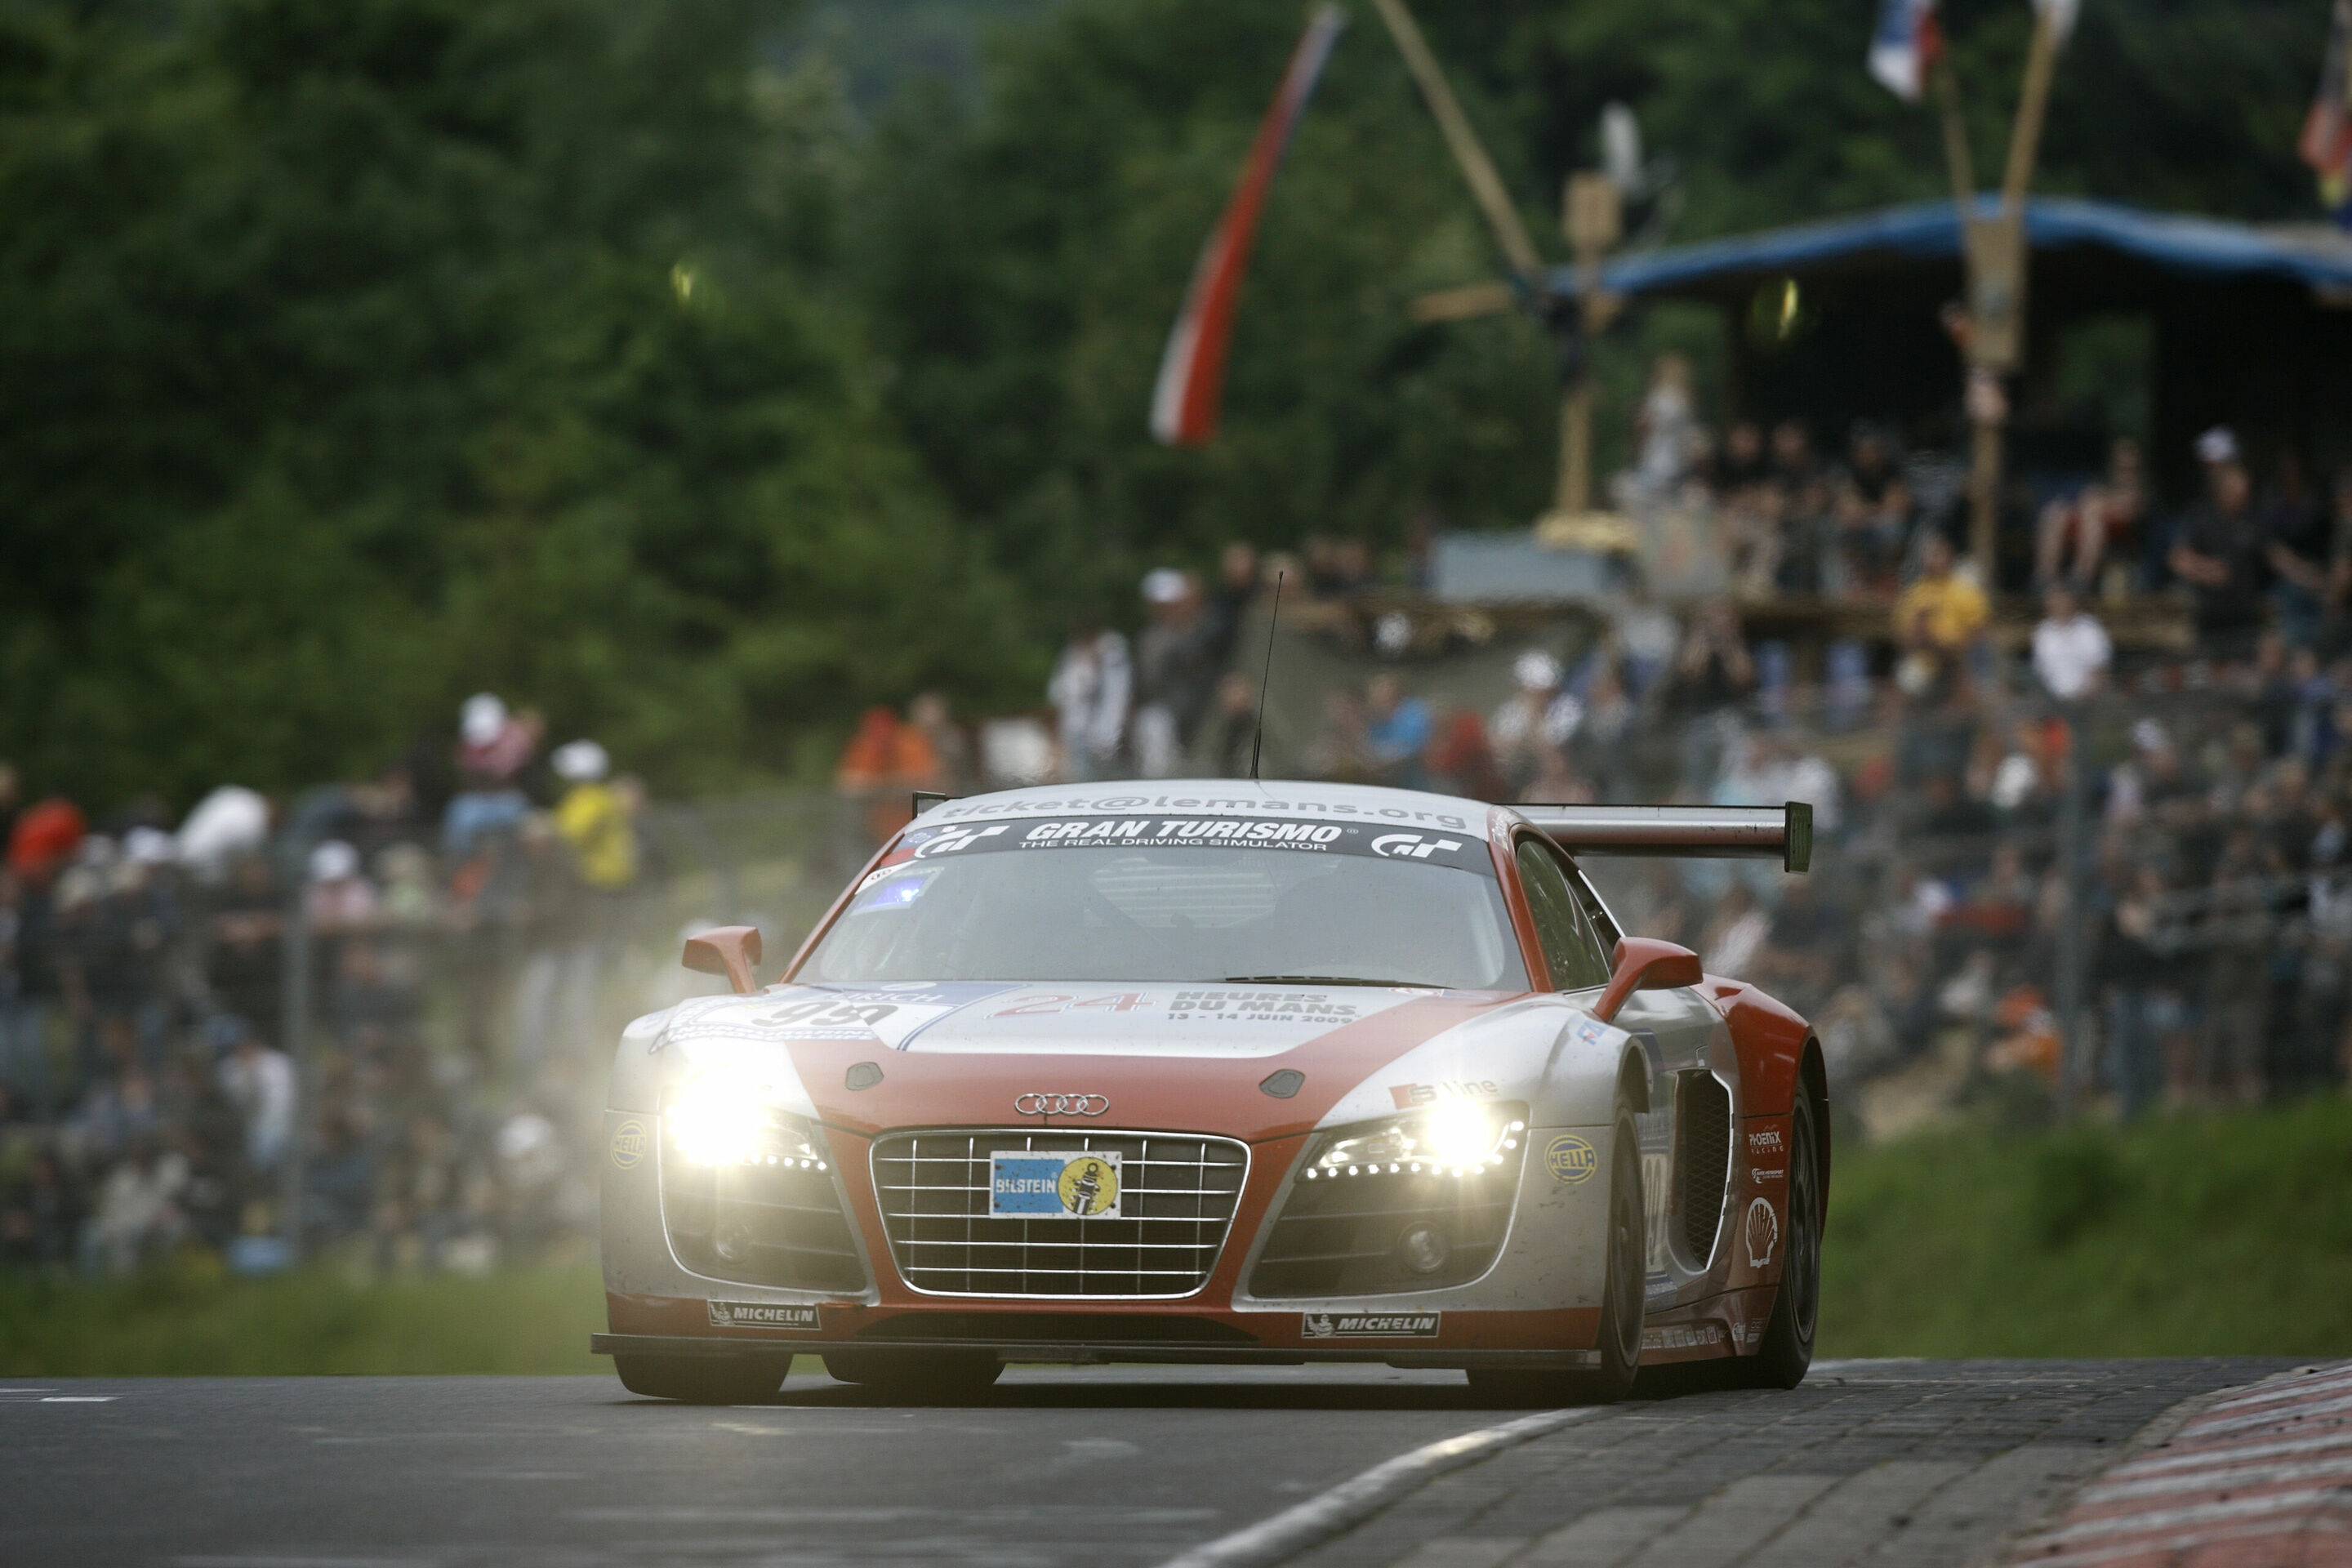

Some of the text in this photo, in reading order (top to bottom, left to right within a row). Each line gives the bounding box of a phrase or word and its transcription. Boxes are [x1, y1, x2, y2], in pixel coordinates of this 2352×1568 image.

[942, 796, 1467, 829] ticket@lemans.org
[1026, 820, 1342, 843] GRAN TURISMO
[1019, 837, 1327, 851] THE REAL DRIVING SIMULATOR
[1175, 991, 1327, 1003] HEURES
[982, 991, 1156, 1019] 24
[1169, 1000, 1357, 1015] DU MANS
[1300, 1015, 1352, 1024] 2009
[1443, 1080, 1499, 1097] line
[1551, 1149, 1595, 1167] HELLA
[996, 1178, 1056, 1194] BILSTEIN
[734, 1307, 813, 1322] MICHELIN
[1337, 1317, 1436, 1330] MICHELIN
